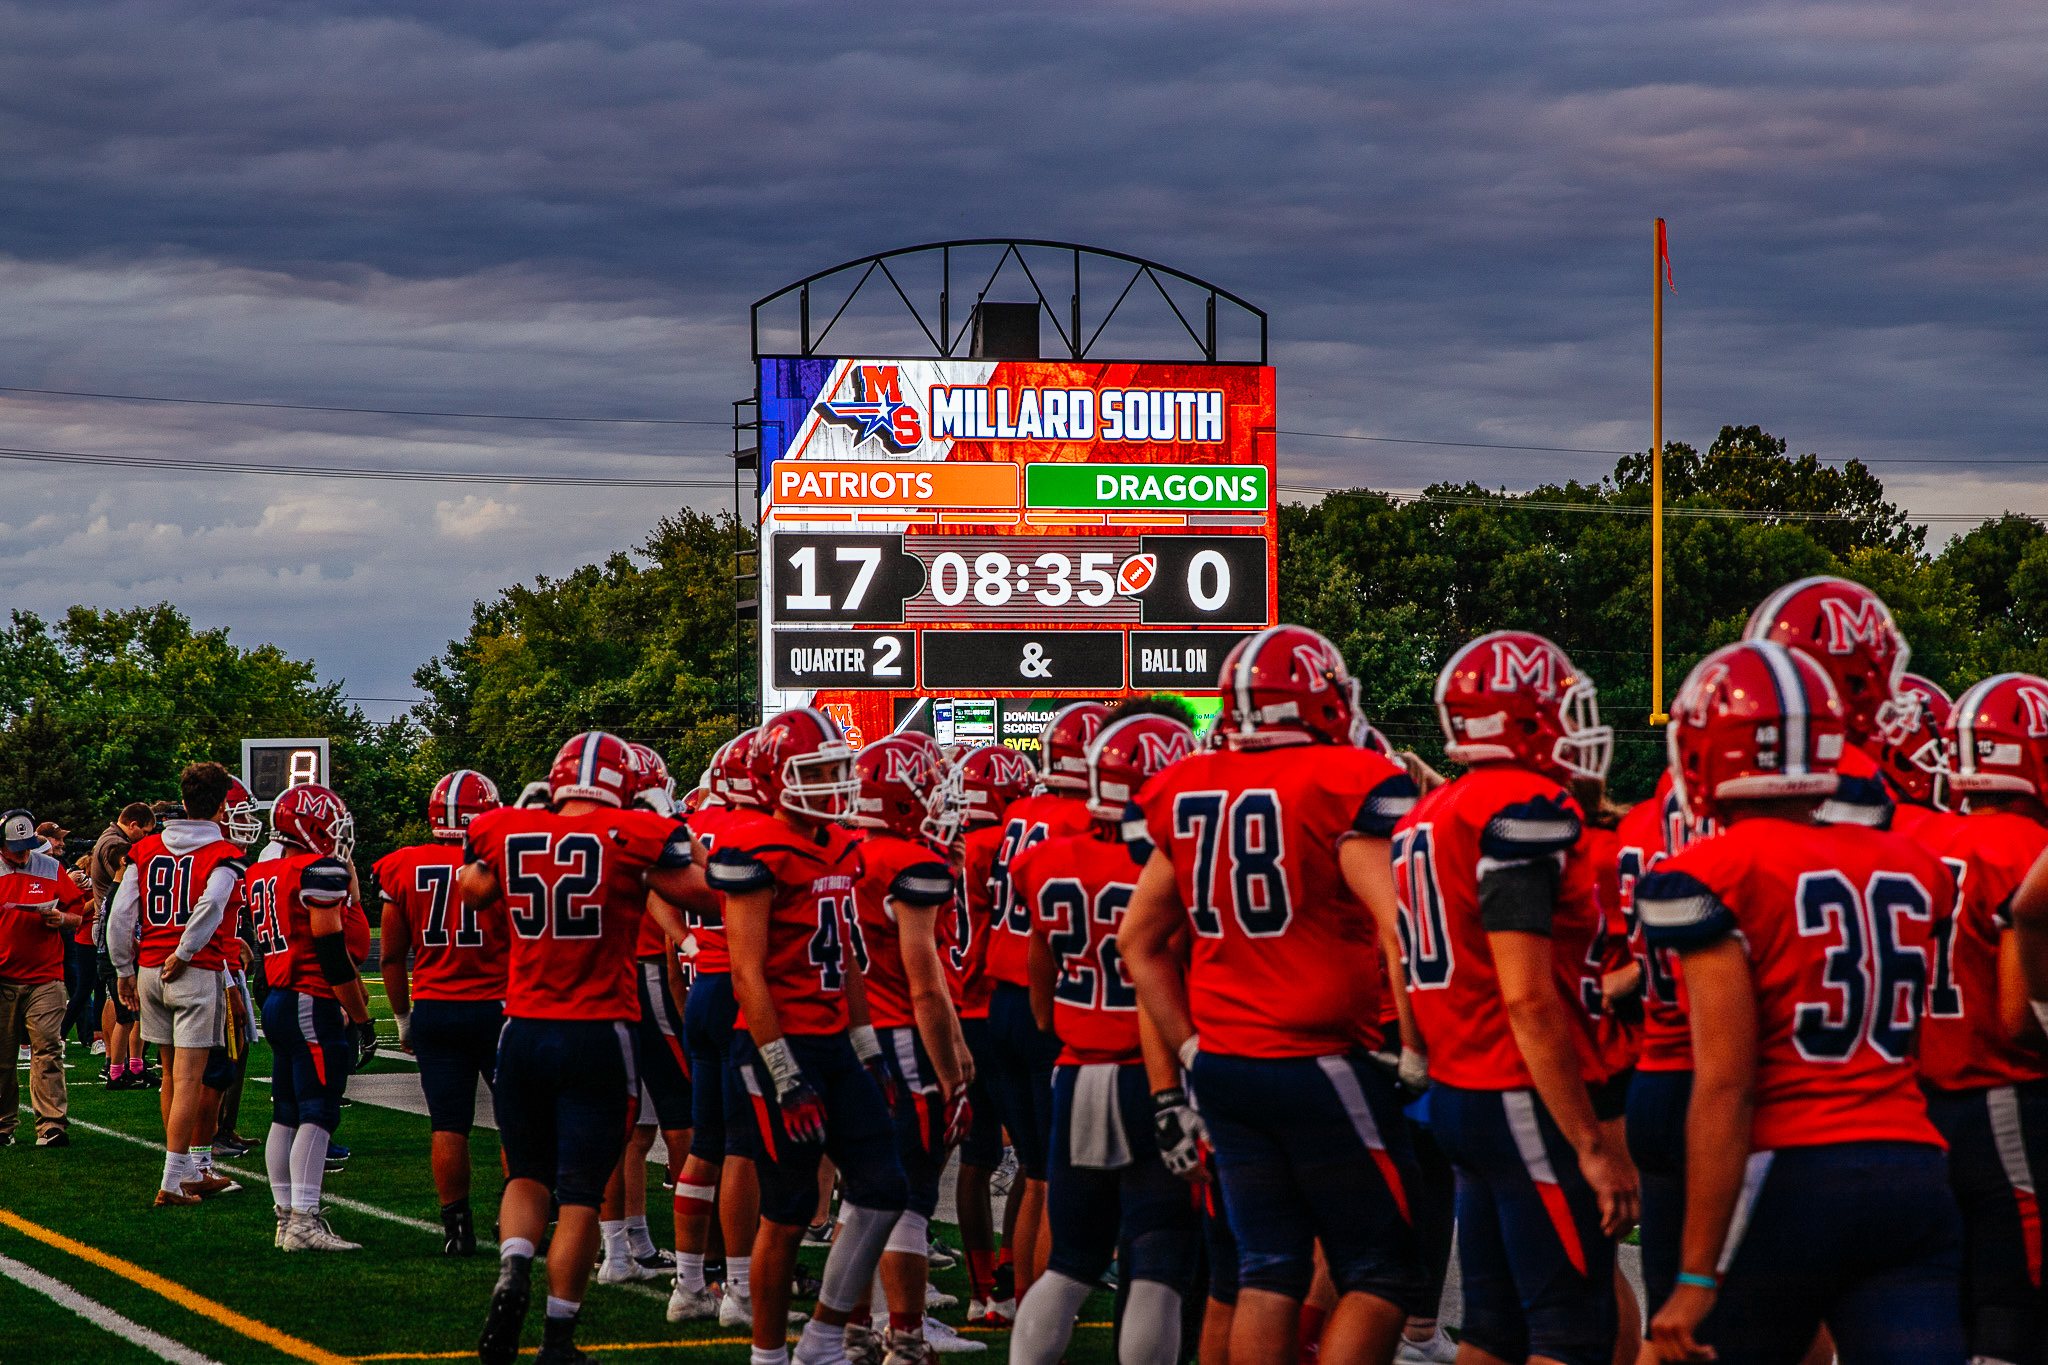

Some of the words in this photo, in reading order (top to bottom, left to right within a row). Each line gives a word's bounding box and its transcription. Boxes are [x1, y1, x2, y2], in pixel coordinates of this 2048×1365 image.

[931, 387, 1095, 440] MILLARD
[1100, 389, 1222, 442] SOUTH
[781, 471, 934, 499] PATRIOTS
[1096, 474, 1258, 502] DRAGONS
[785, 546, 882, 611] 17
[930, 551, 1116, 608] 08:35
[1186, 549, 1231, 612] 0
[790, 648, 866, 676] QUARTER
[872, 636, 902, 677] 2
[1019, 642, 1053, 679] &
[1141, 648, 1182, 674] BALL
[1185, 648, 1207, 674] ON
[1491, 641, 1556, 699] M
[1003, 711, 1060, 722] DOWNLOA
[1003, 738, 1042, 751] SVFA
[885, 748, 926, 786] M
[991, 754, 1029, 786] M
[295, 790, 330, 820] M
[146, 854, 194, 927] 81
[504, 832, 603, 939] 52
[1173, 788, 1293, 939] 78
[251, 875, 289, 956] 21
[415, 864, 483, 947] 71
[1037, 877, 1138, 1011] 22
[1792, 868, 1932, 1064] 36
